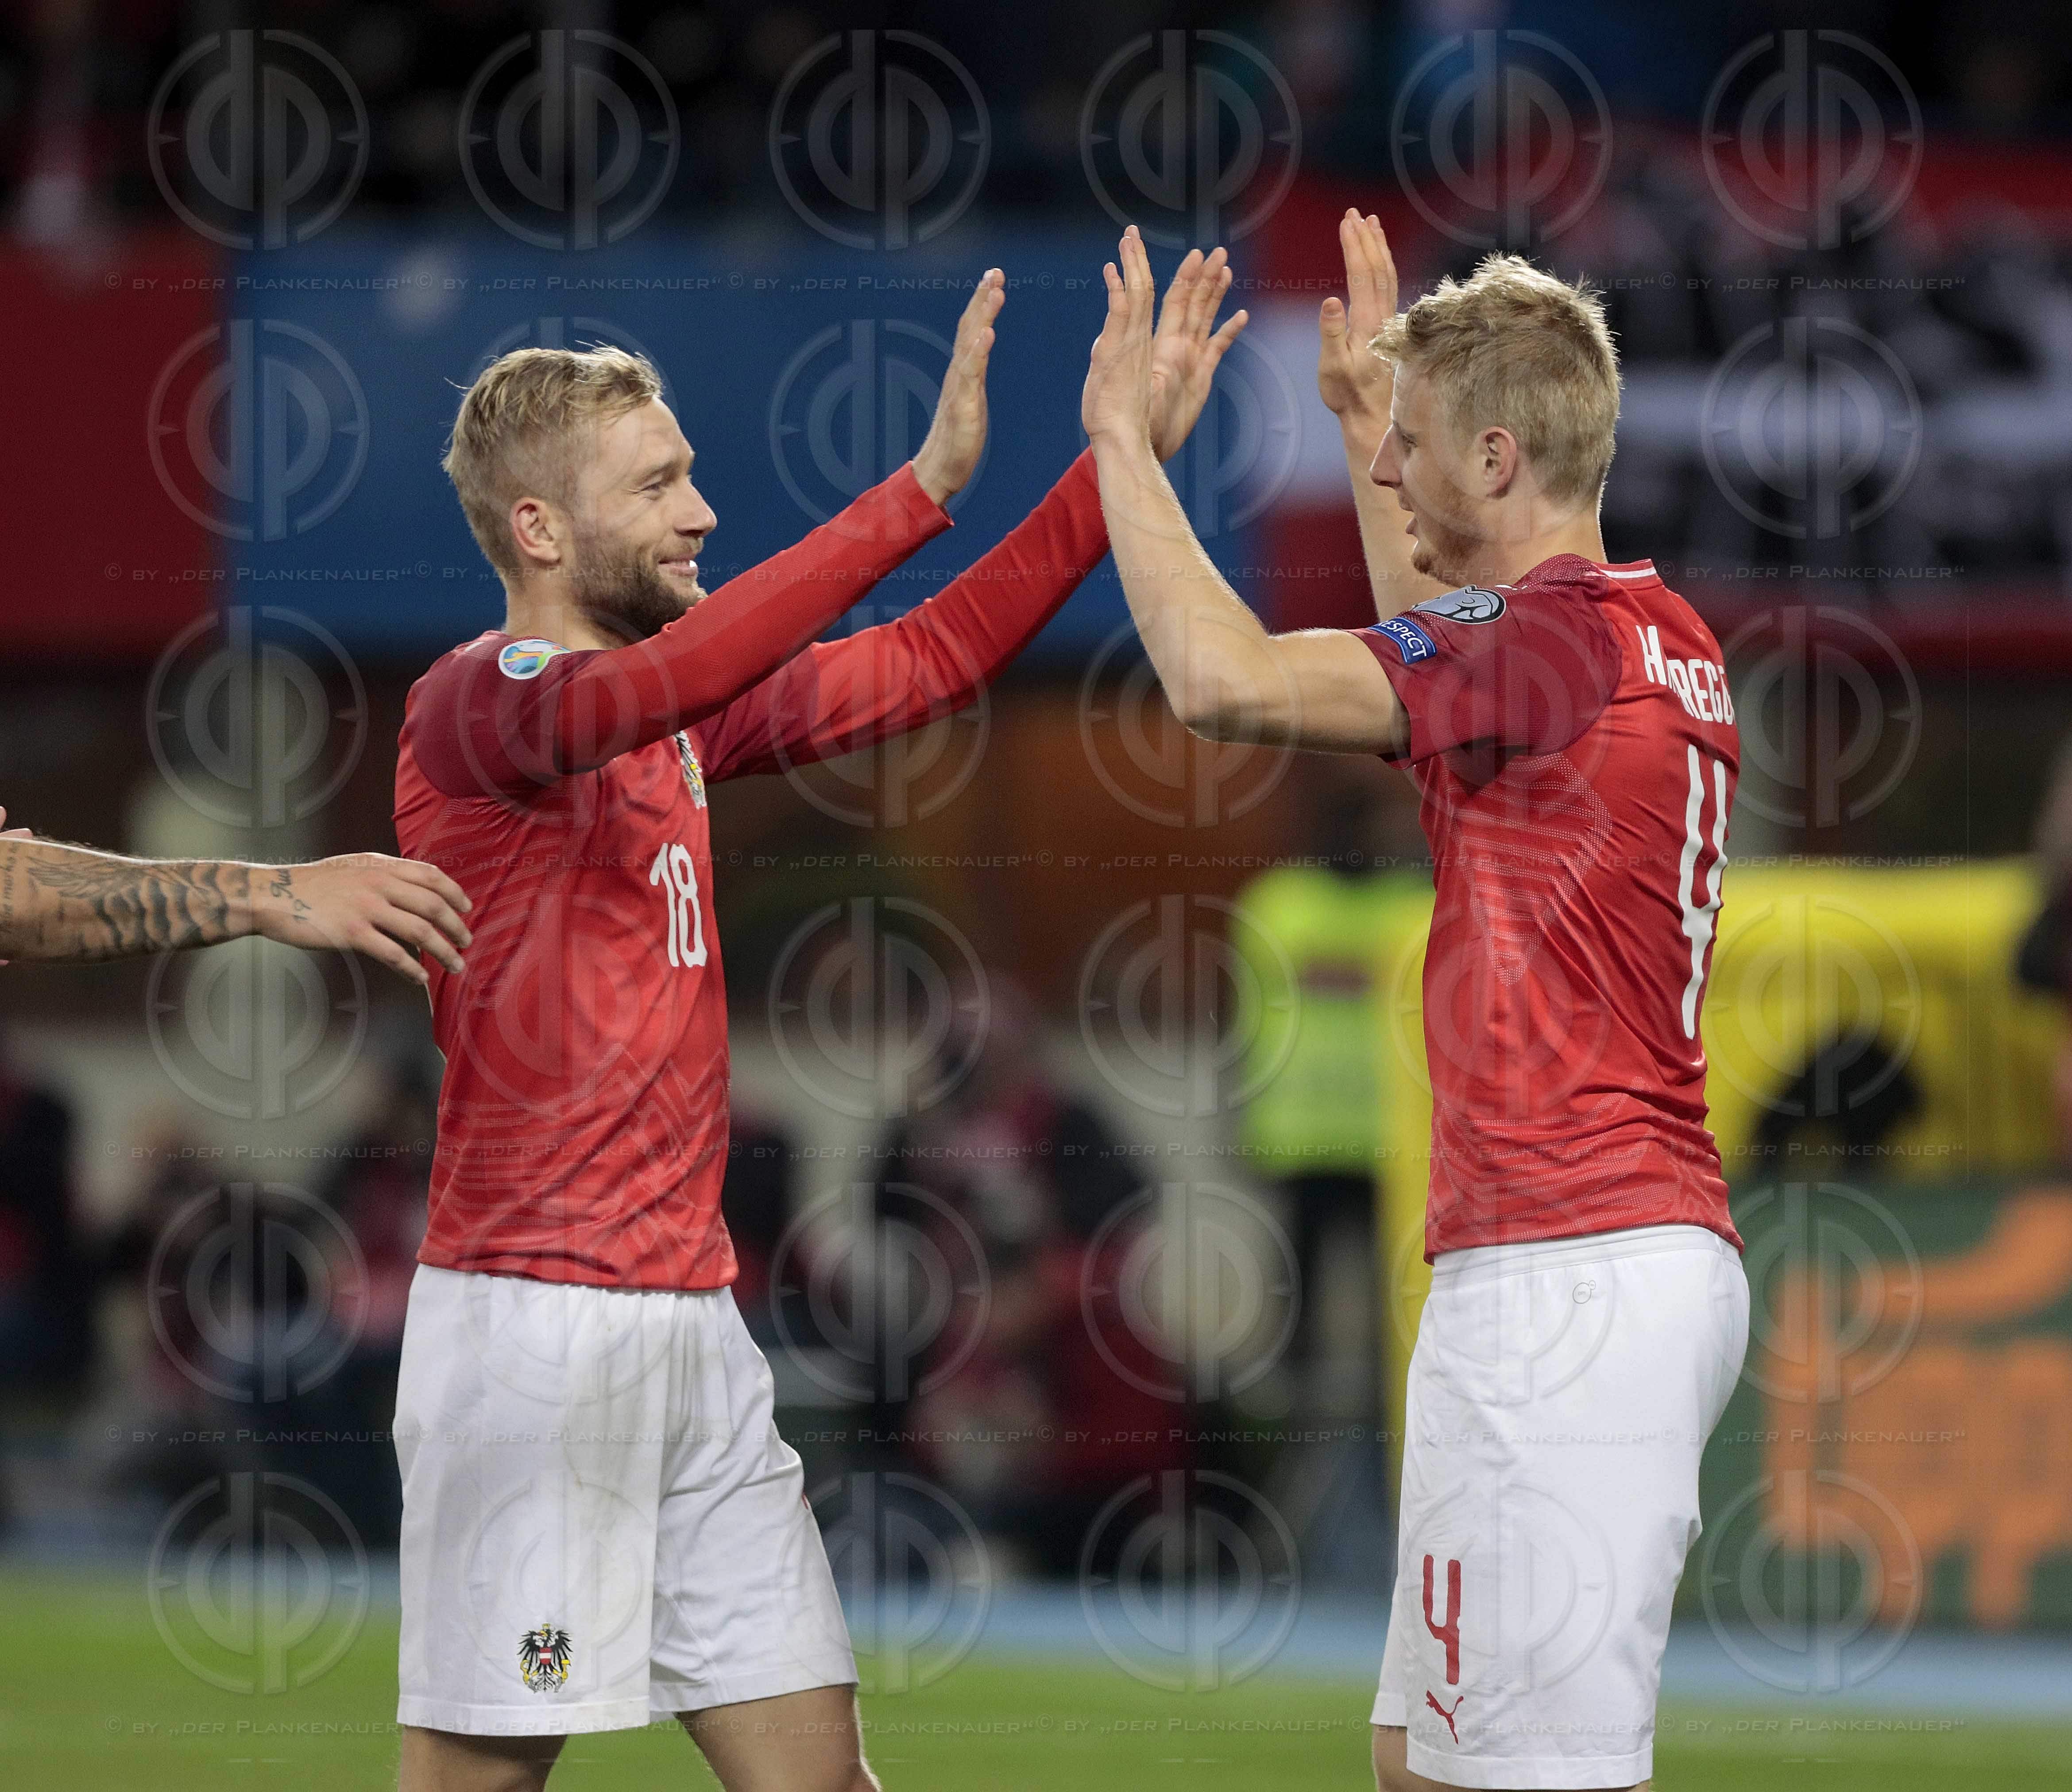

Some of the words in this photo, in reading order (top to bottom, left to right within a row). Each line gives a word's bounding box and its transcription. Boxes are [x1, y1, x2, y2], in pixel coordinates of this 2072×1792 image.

[649, 842, 708, 967] 18
[1678, 744, 1728, 1039] 4
[1423, 1554, 1461, 1685] 4
